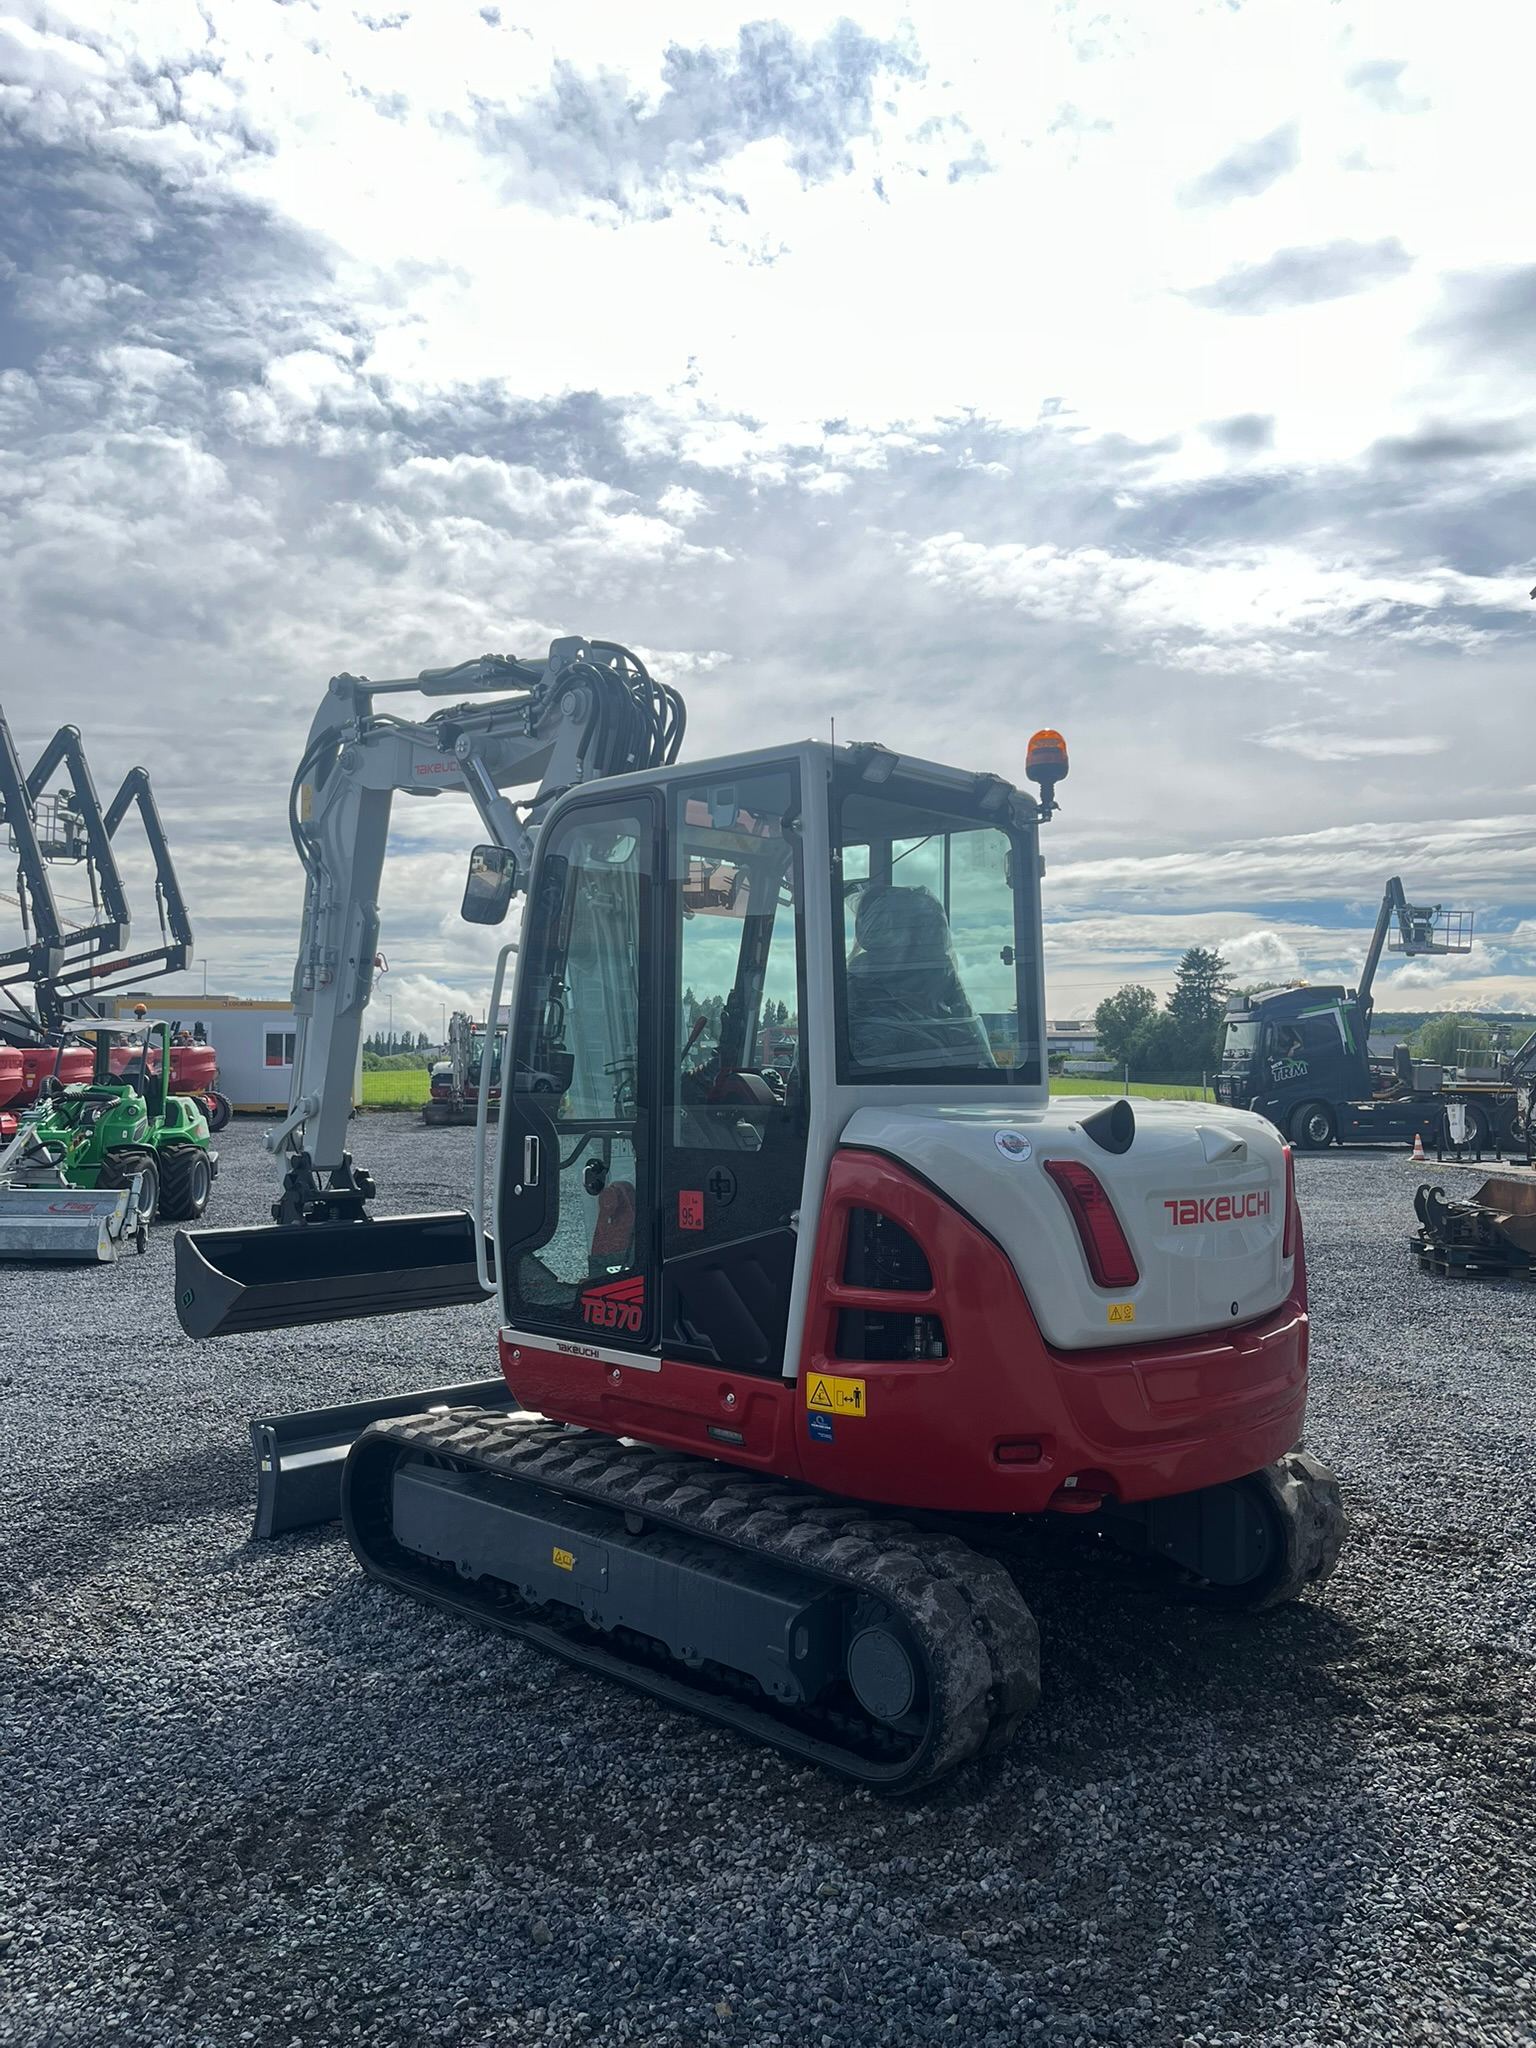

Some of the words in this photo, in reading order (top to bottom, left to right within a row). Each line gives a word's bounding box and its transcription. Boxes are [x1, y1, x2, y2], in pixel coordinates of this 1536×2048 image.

[415, 760, 461, 776] TAKEUC
[1271, 1061, 1309, 1082] TRM
[682, 1207, 694, 1226] 95
[1163, 1190, 1270, 1226] TAKEUCHI
[580, 1297, 643, 1332] TB370
[556, 1342, 600, 1359] TAKEUCHI
